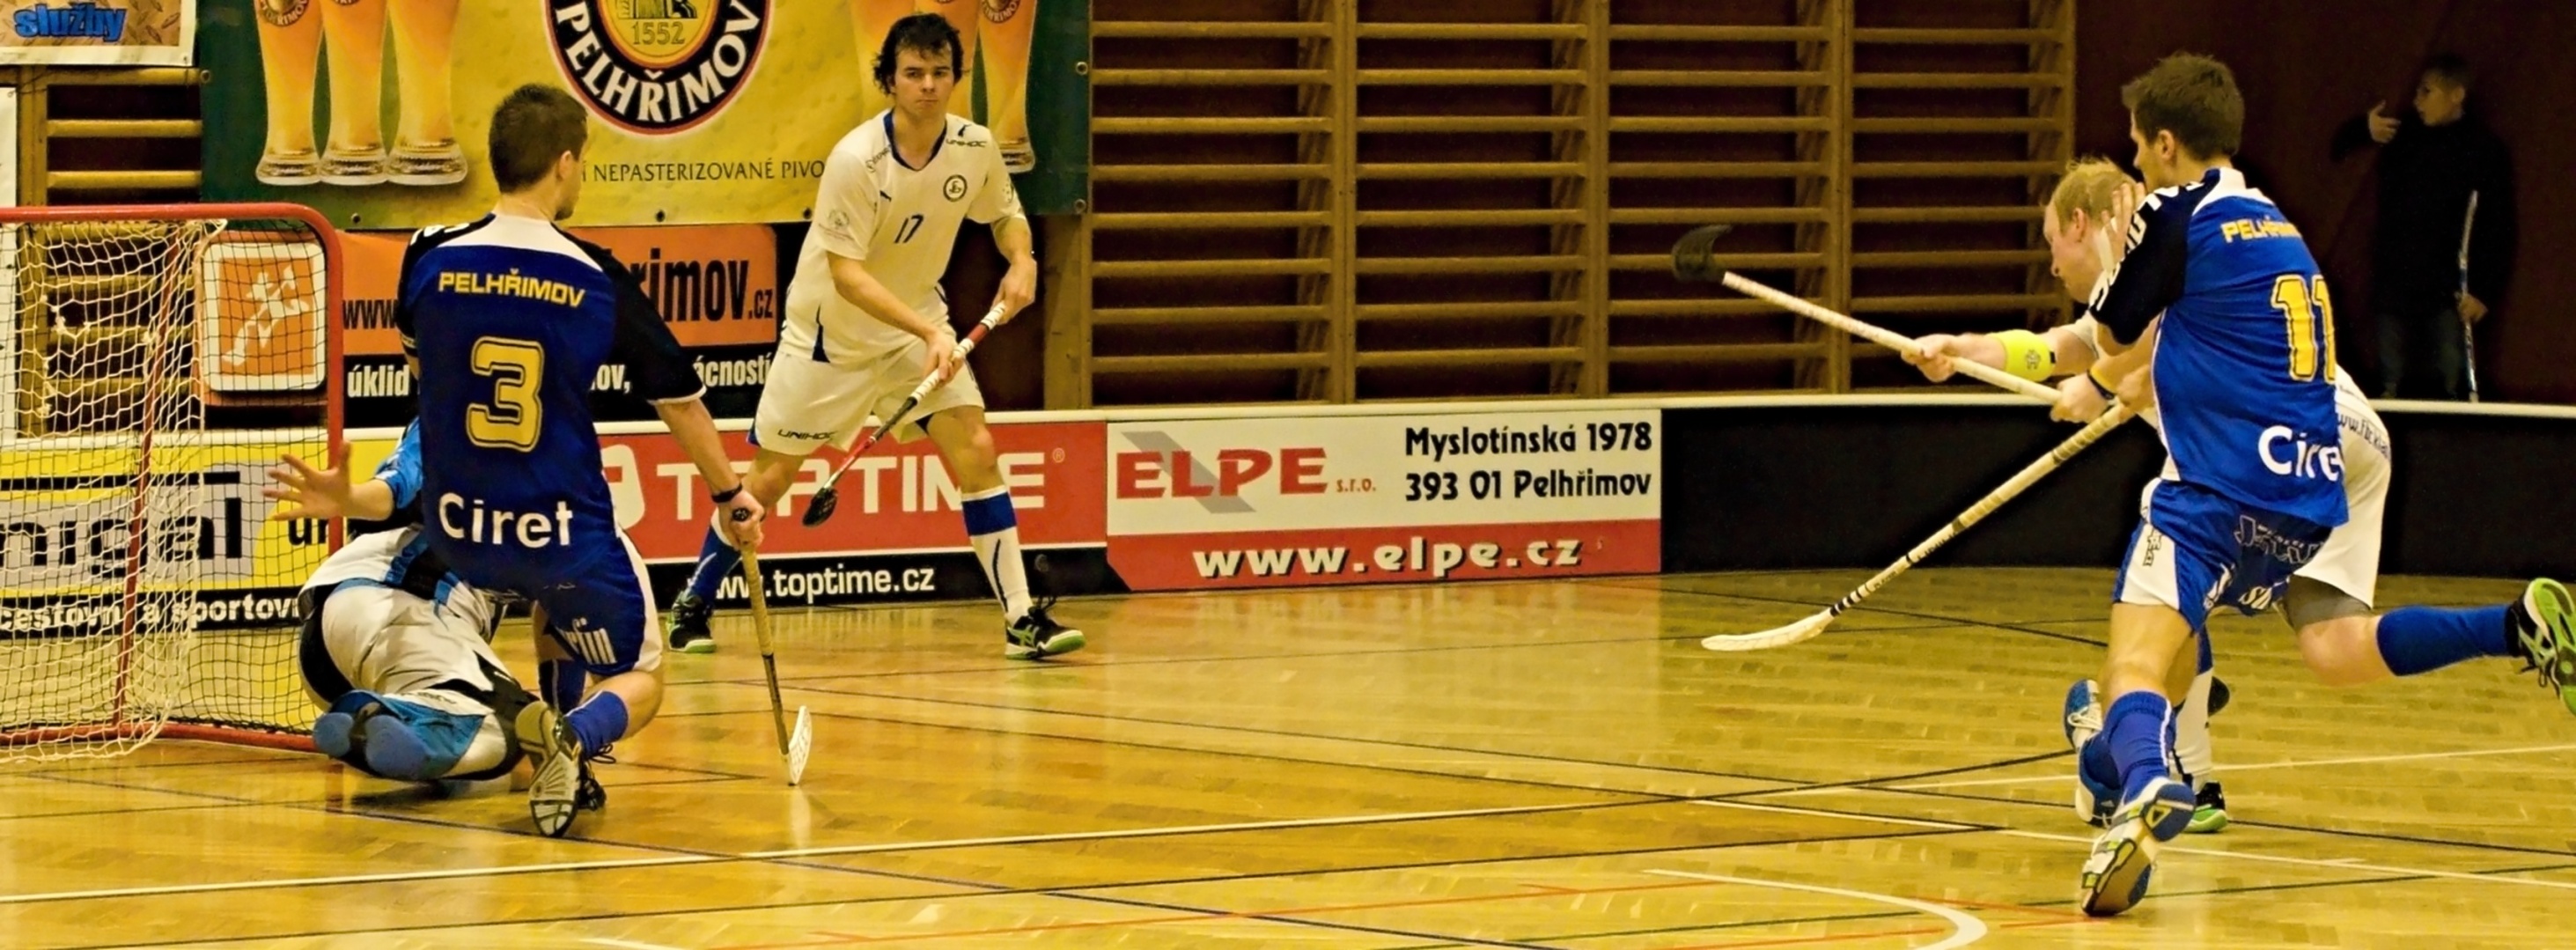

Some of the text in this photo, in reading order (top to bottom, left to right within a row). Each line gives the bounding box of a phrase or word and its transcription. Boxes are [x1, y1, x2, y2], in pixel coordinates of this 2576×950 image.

[14, 3, 127, 42] služby
[631, 21, 685, 46] 1552
[556, 0, 760, 123] PELHŘIMOV
[593, 158, 776, 182] NEPASTERIZOVANÉ
[782, 160, 826, 179] PIVO
[894, 214, 924, 244] 17
[438, 268, 585, 307] PELHŘIMOV
[2271, 275, 2336, 385] 11
[347, 365, 410, 398] úklid
[467, 336, 544, 453] 3
[1405, 422, 1652, 462] Myslotínská 1978
[2258, 425, 2345, 482] Cire
[657, 453, 1045, 521] TPTIME
[1116, 447, 1376, 499] ELPE s.r.o.
[1405, 468, 1652, 502] 393 01 Pelhřimov
[439, 492, 573, 549] Ciret
[1193, 536, 1584, 579] www.elpe.cz
[688, 563, 935, 604] w.toptime.cz
